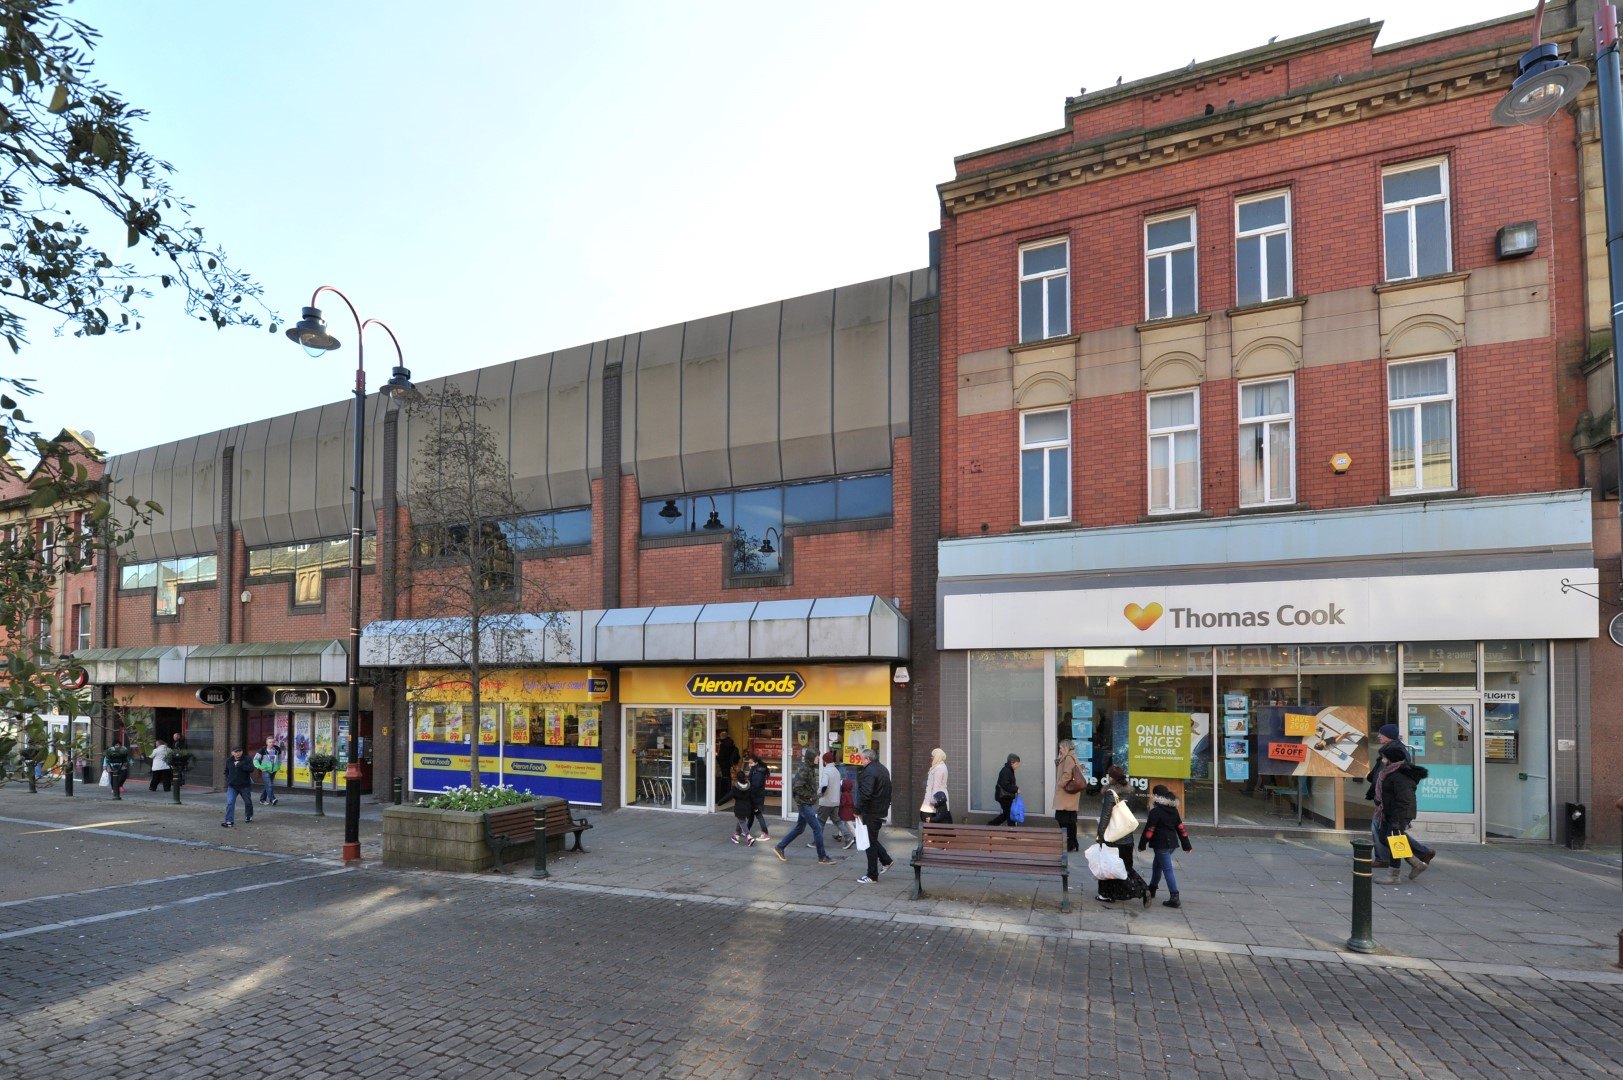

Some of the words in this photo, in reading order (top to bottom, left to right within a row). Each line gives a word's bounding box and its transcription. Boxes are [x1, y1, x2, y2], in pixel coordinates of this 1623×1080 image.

[1169, 607, 1270, 629] Thomas
[1276, 602, 1346, 627] Cook
[692, 676, 743, 693] Heron
[744, 675, 796, 693] Foods
[207, 694, 225, 702] HILL
[306, 692, 321, 704] HILL
[1484, 692, 1516, 700] FLIGHTS
[1290, 715, 1310, 723] SAVE
[1135, 724, 1184, 736] ONLINE
[1137, 735, 1182, 748] PRICES
[1143, 748, 1176, 756] IN-STORE
[421, 758, 436, 766] Heron
[436, 758, 450, 766] Foods
[512, 763, 529, 771] Heron
[529, 764, 546, 772] Foods
[1423, 778, 1459, 787] TRAVEL
[1422, 786, 1459, 795] MONEY
